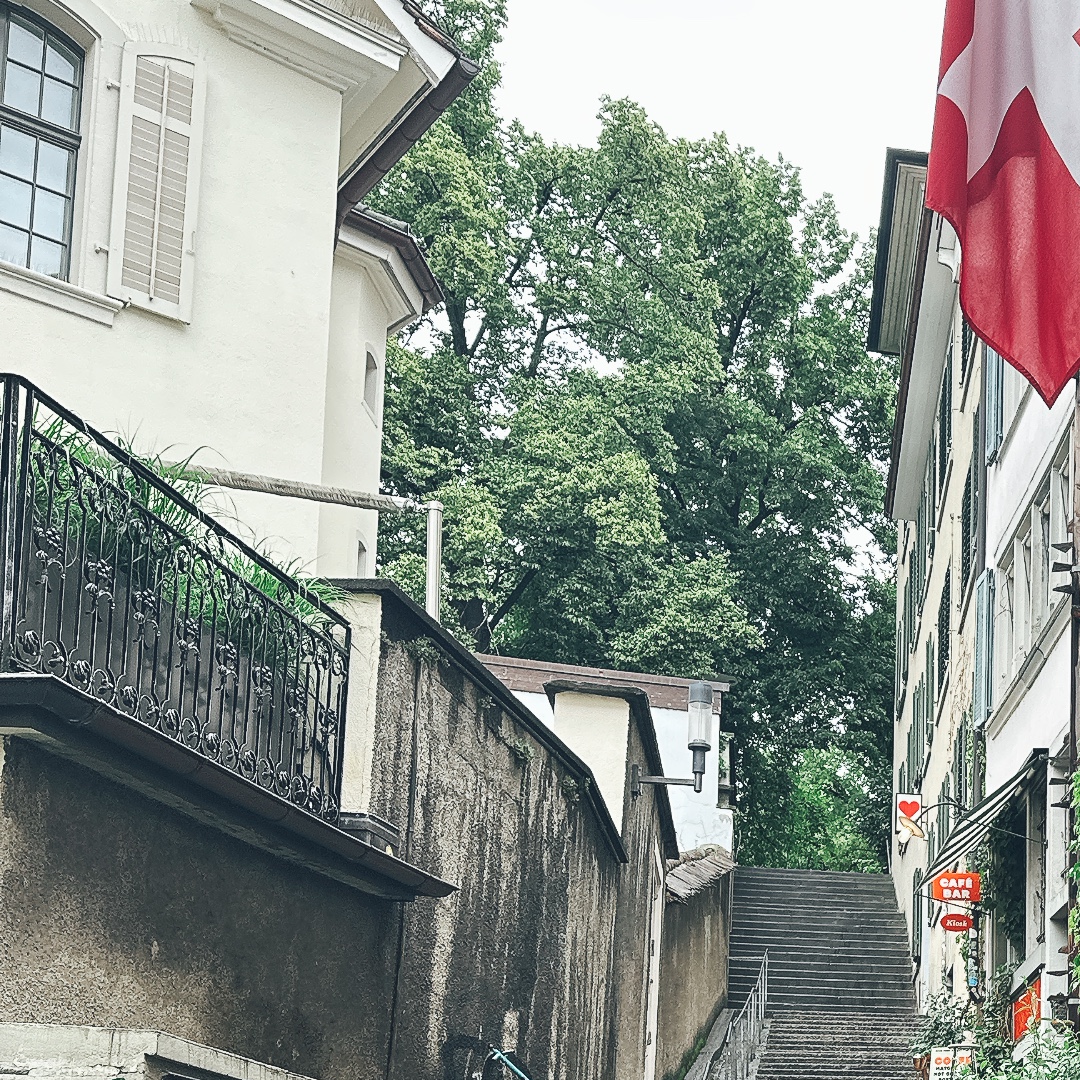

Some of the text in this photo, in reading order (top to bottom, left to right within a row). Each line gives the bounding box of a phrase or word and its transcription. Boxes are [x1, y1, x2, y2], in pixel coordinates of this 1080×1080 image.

[939, 877, 973, 888] CAFÉ
[943, 888, 970, 899] BAR
[945, 919, 967, 927] Kiosk
